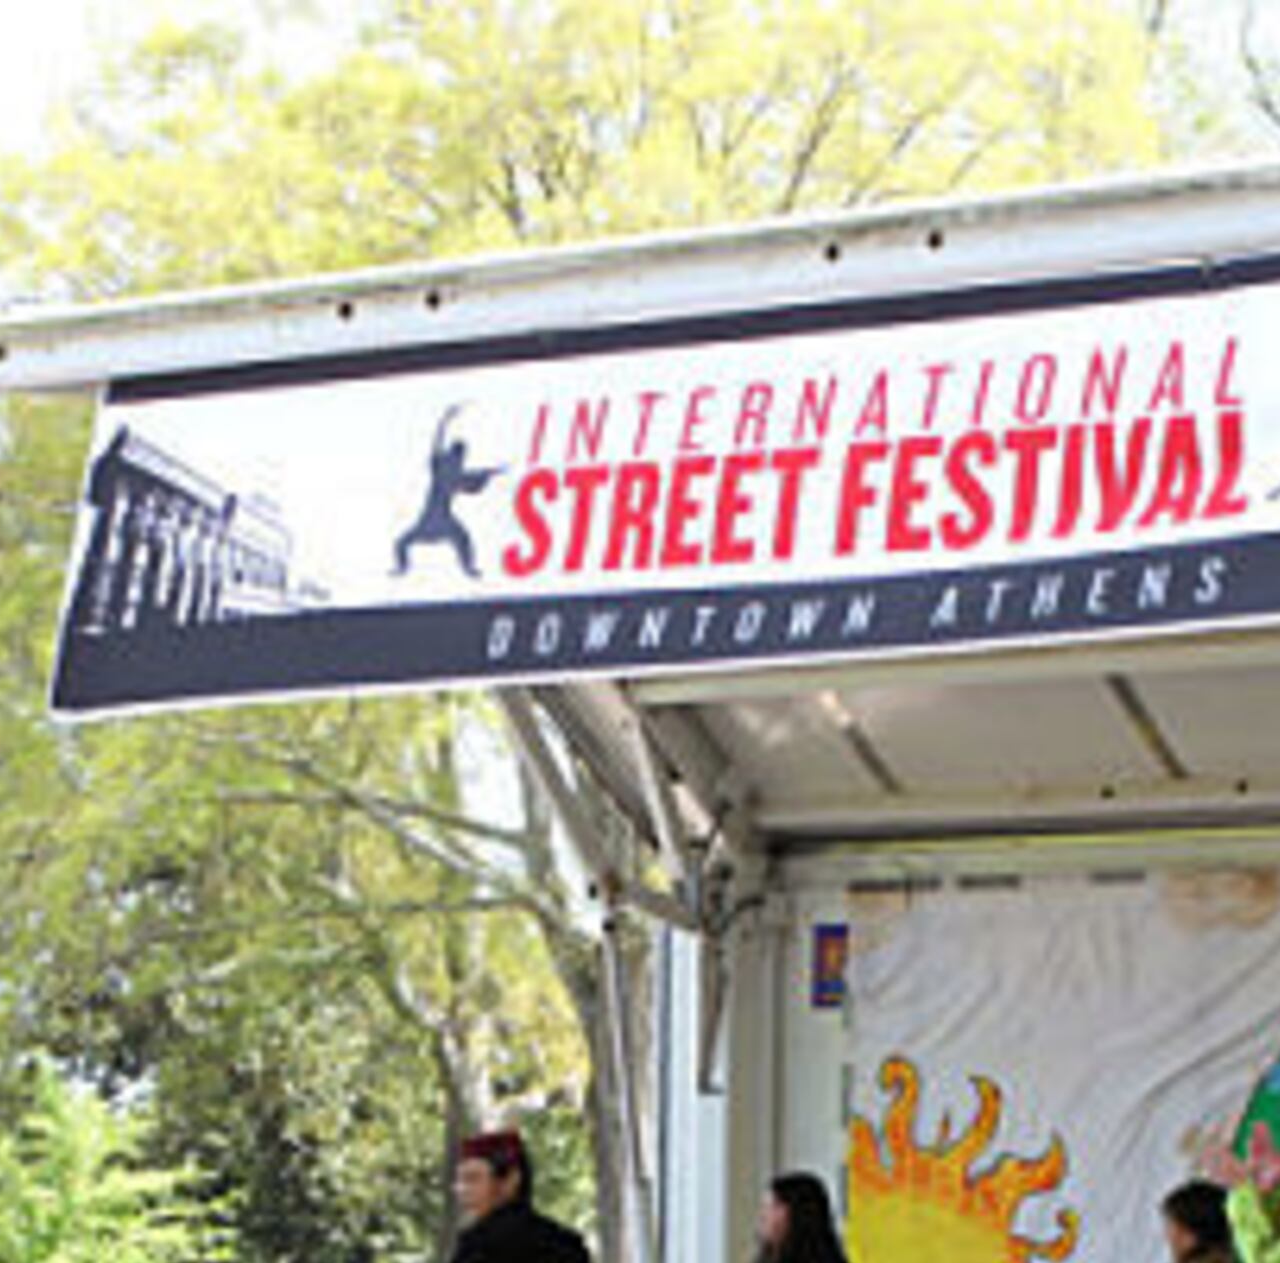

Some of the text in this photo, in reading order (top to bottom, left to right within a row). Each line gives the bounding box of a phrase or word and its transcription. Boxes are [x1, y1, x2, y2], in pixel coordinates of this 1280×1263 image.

[525, 336, 1245, 465] INTERNATIONAL
[500, 409, 1250, 580] STREET FESTIVAL
[485, 555, 1228, 661] DOWNTOWN ATHENS
